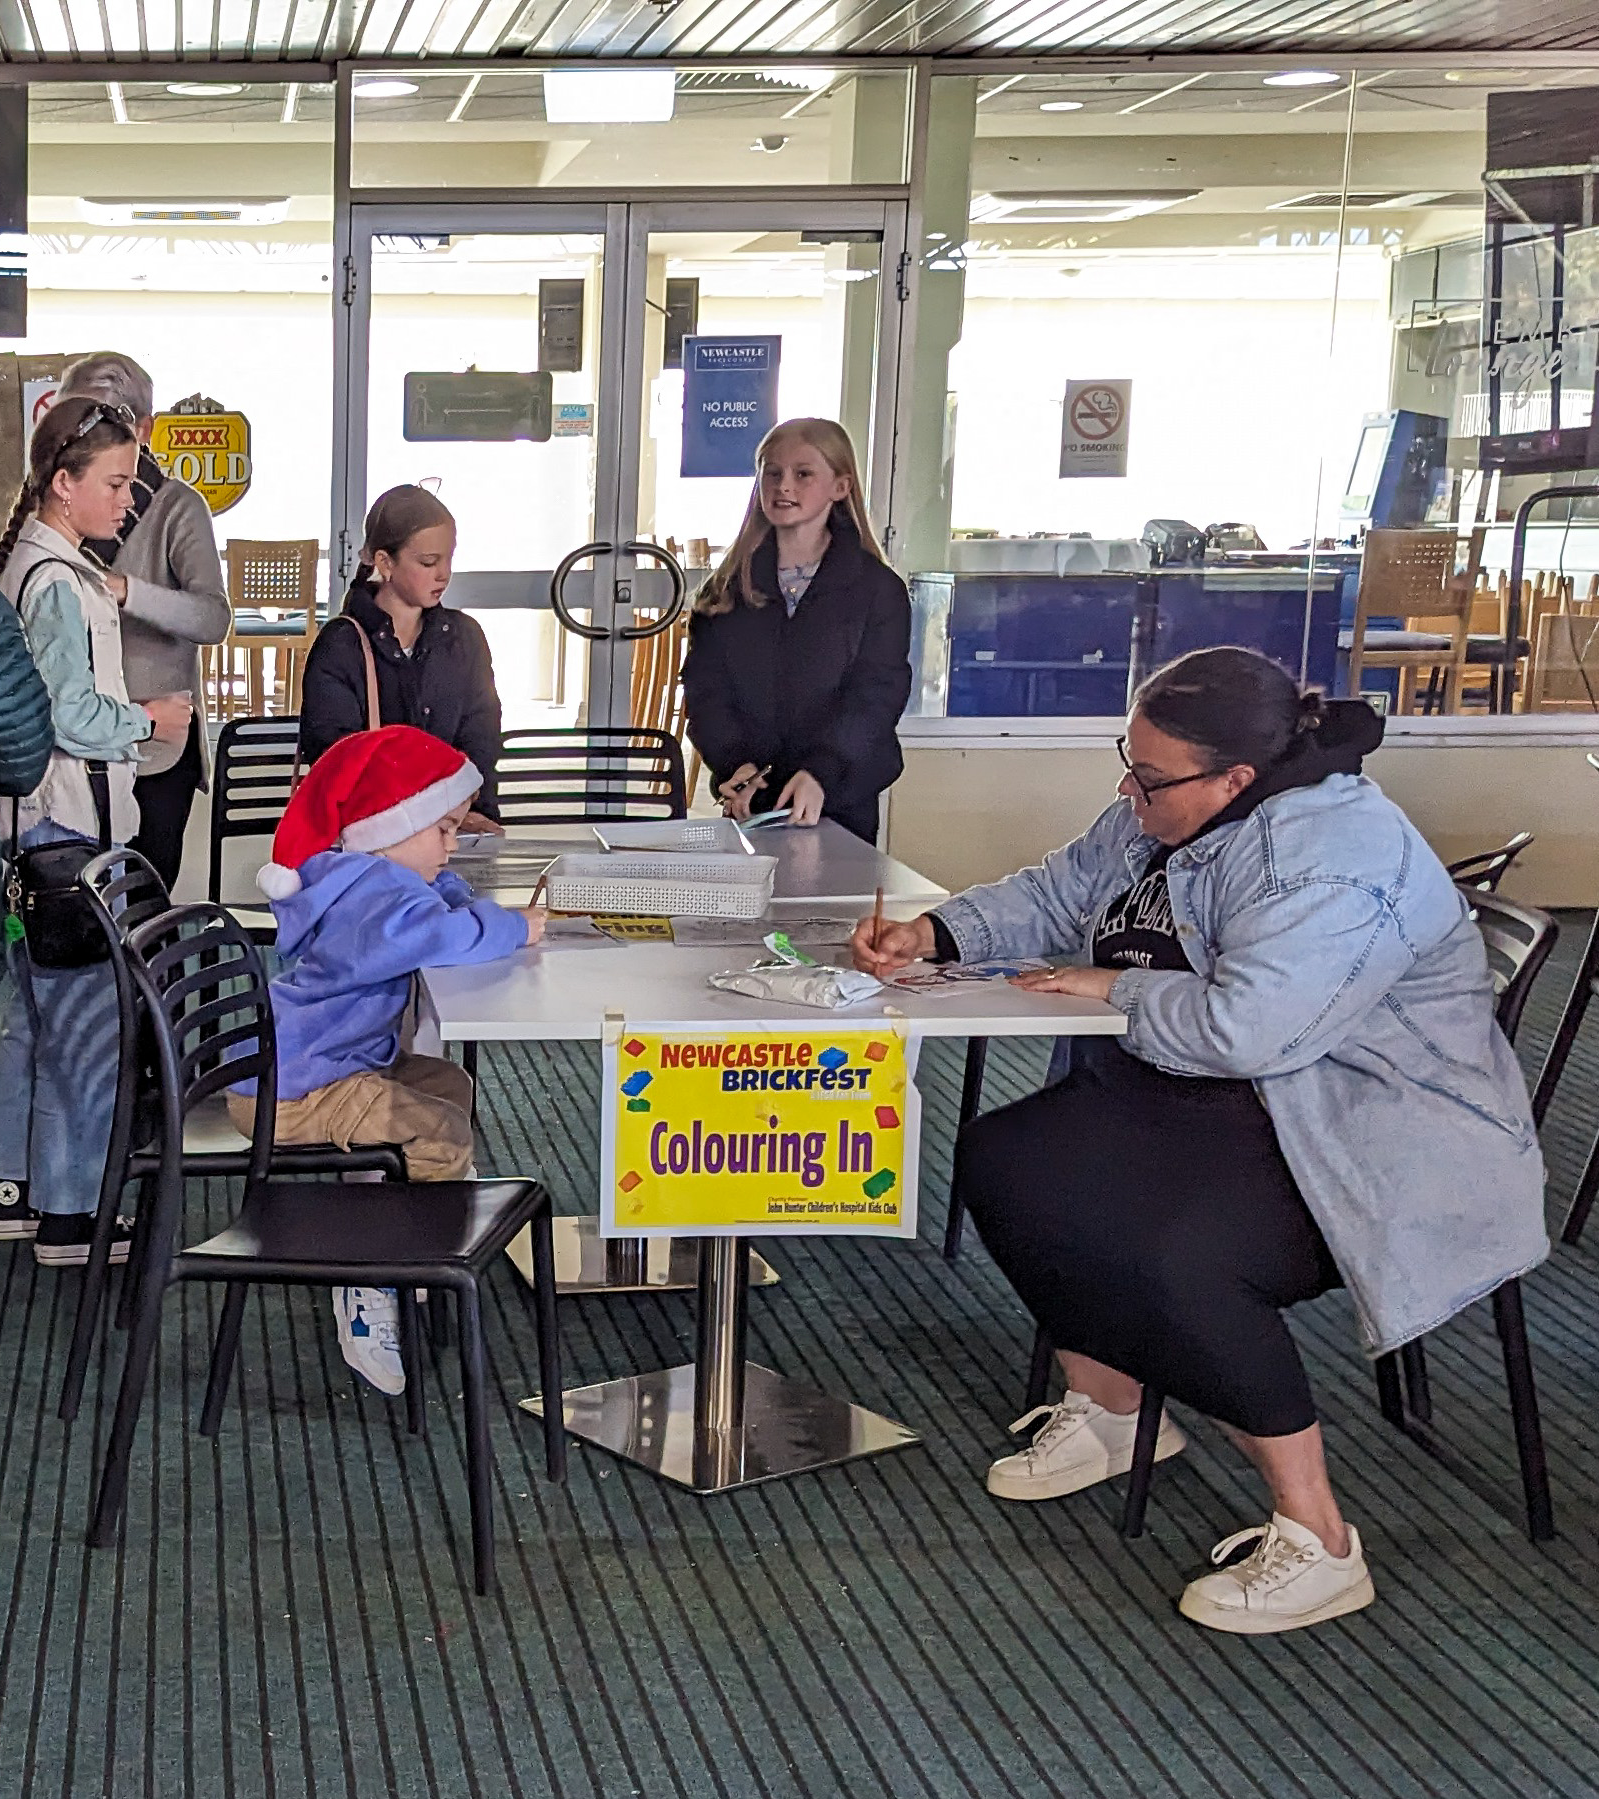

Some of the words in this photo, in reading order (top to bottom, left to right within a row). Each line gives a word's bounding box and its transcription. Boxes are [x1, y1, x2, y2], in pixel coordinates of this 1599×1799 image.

[701, 348, 765, 357] NEWCASTLE
[702, 402, 721, 412] NO
[723, 401, 757, 412] PUBLIC
[710, 416, 749, 428] ACCESS
[173, 429, 224, 446] XXXX
[1064, 443, 1077, 452] NO
[1081, 443, 1125, 452] SMOKING
[651, 1115, 826, 1188] Colouring
[838, 1119, 873, 1173] In
[767, 1202, 783, 1214] John
[807, 1201, 839, 1214] Children's
[840, 1201, 866, 1216] Hospital
[868, 1202, 882, 1214] Kids
